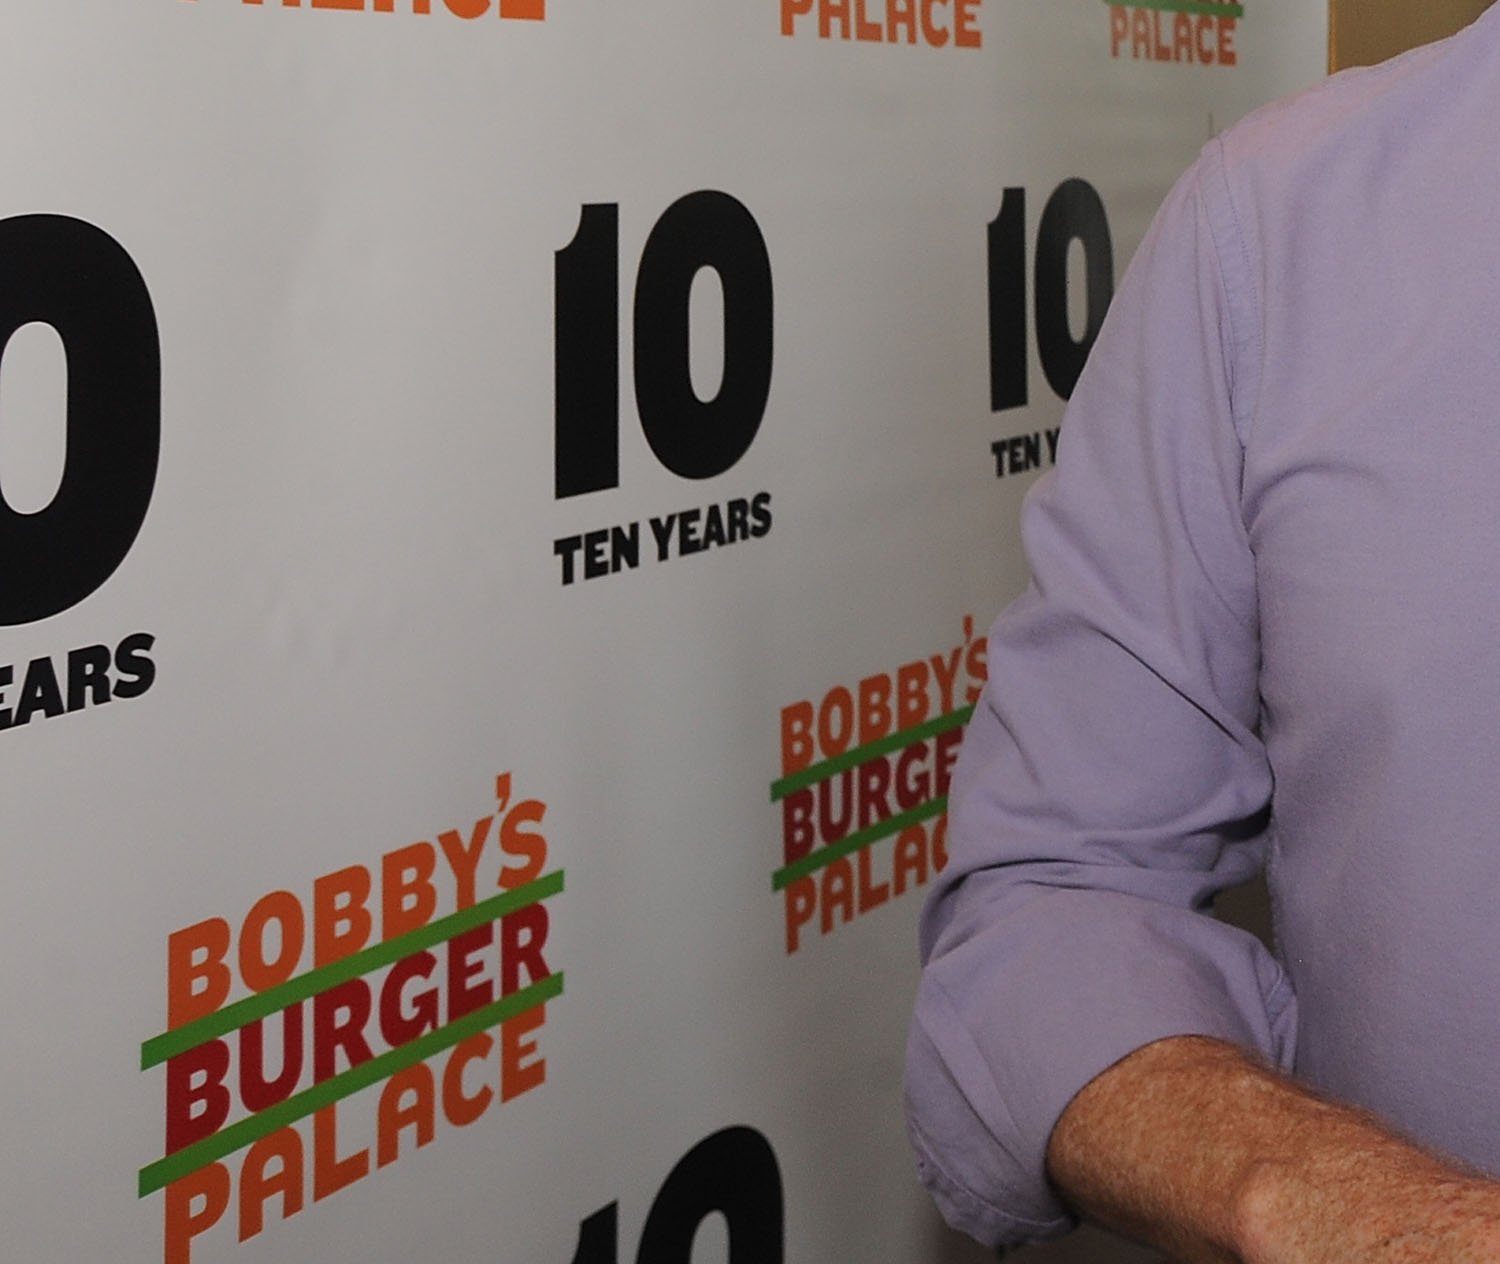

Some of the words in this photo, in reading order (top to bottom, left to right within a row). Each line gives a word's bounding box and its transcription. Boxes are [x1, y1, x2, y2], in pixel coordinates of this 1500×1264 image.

[1110, 3, 1237, 66] PALACE
[554, 189, 774, 500] 10
[987, 178, 1115, 413] 10
[554, 522, 639, 586] TEN
[649, 492, 773, 562] YEARS
[991, 432, 1041, 478] TEN
[168, 772, 547, 1033] BOBBY'S
[783, 727, 963, 861] BURGE
[164, 1002, 546, 1264] PALACE
[165, 902, 551, 1155] BURGER
